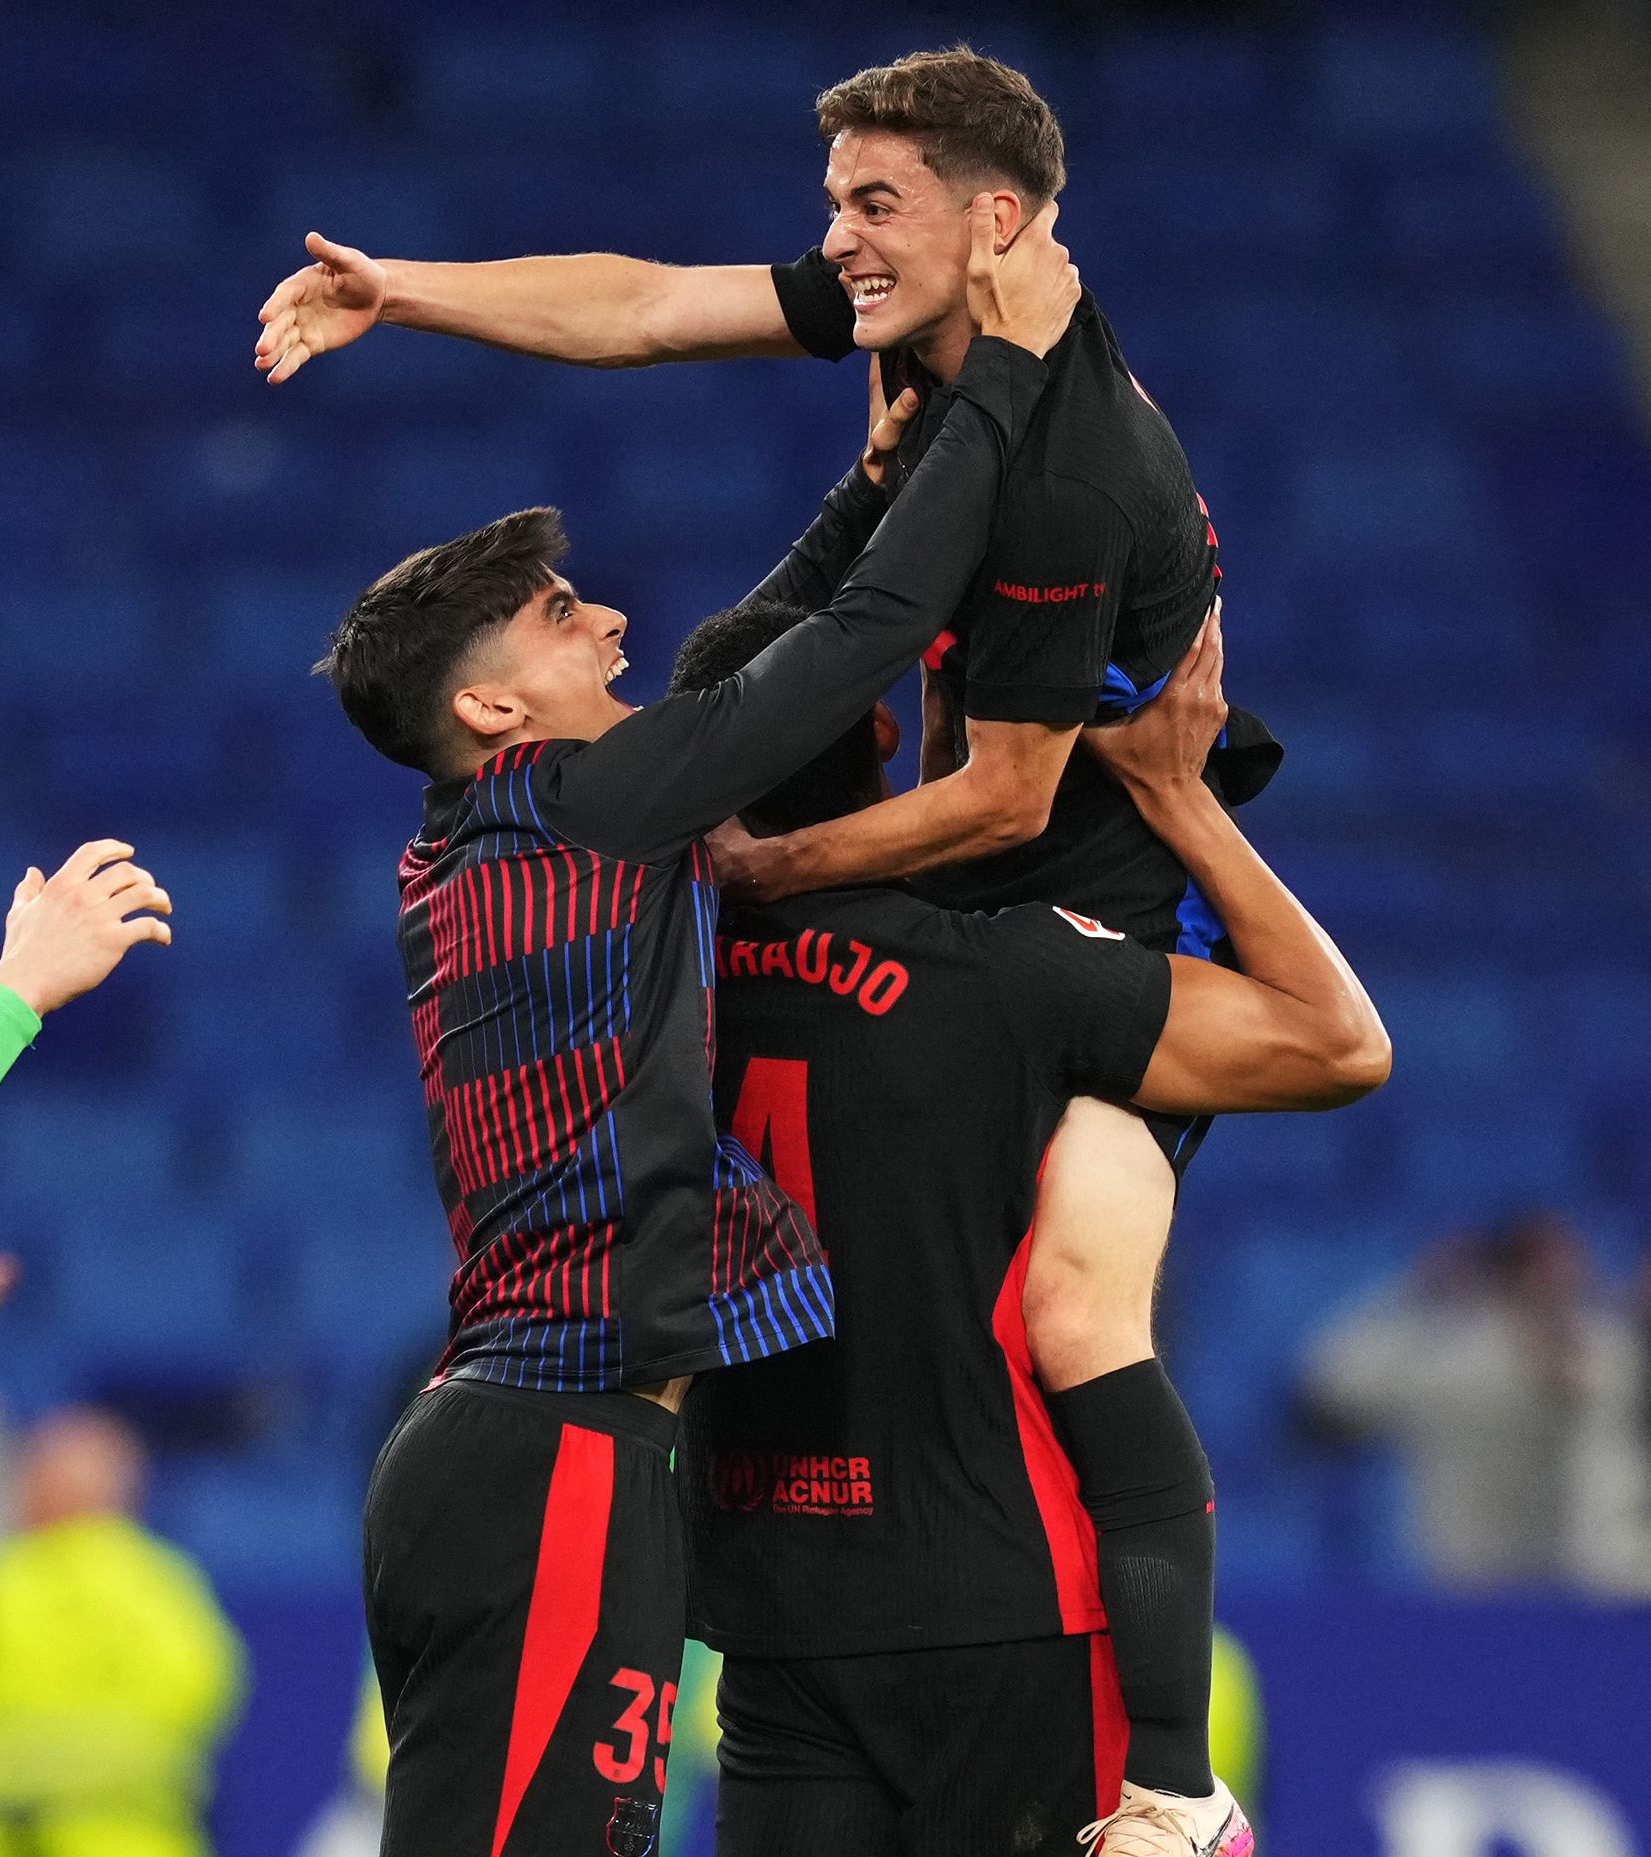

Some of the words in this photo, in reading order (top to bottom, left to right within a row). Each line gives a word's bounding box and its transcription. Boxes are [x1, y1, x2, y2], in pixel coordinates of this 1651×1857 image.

[994, 579, 1089, 603] AMBILIGHT
[773, 1456, 871, 1480] UNHCR
[773, 1479, 873, 1504] ACNUR
